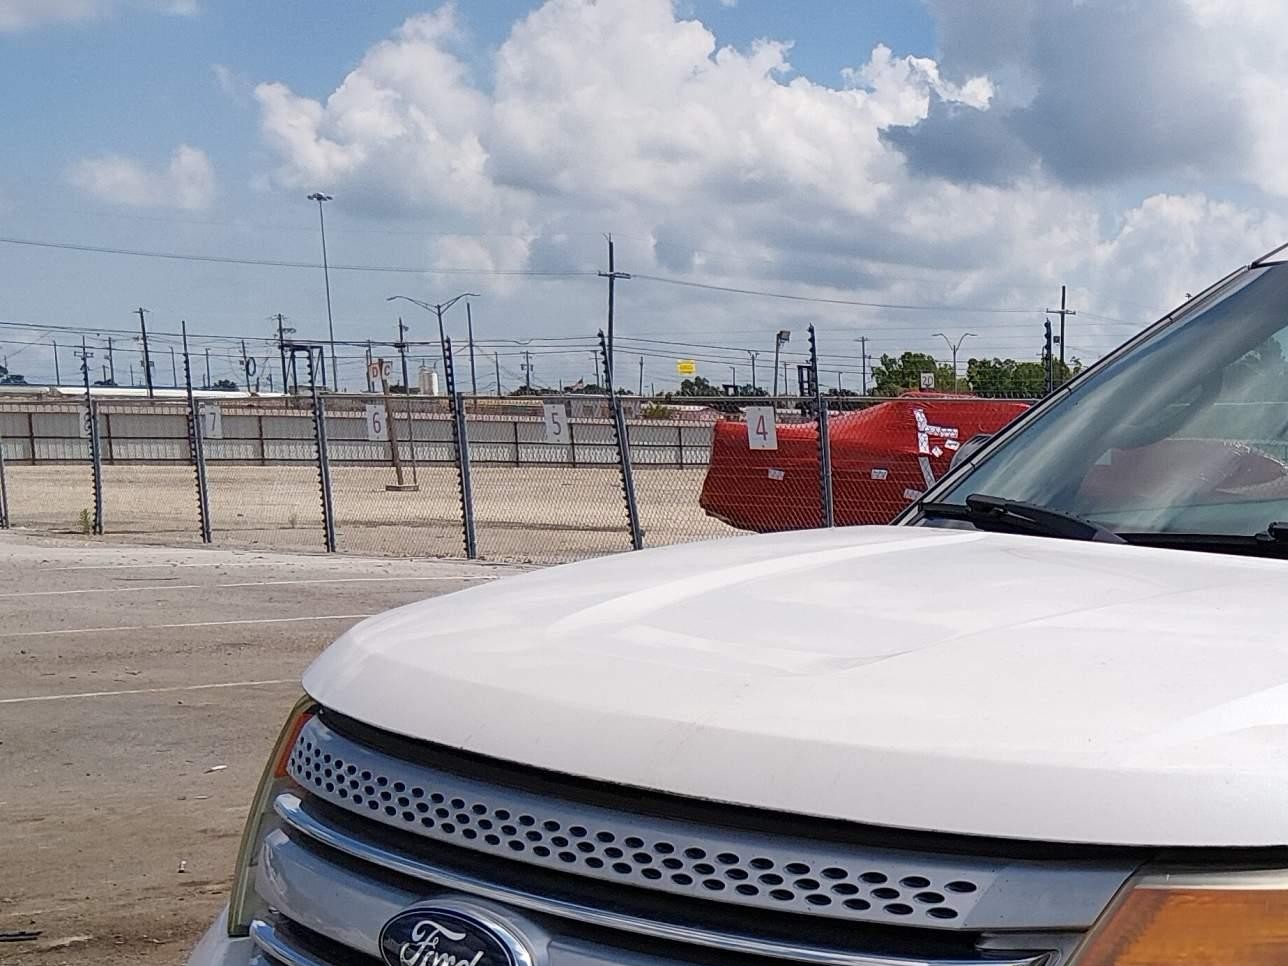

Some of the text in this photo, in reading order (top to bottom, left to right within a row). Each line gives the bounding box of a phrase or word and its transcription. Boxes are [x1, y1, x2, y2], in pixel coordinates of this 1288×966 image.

[922, 375, 934, 387] 20
[209, 412, 217, 432] 7
[372, 411, 382, 434] 6
[551, 412, 562, 435] 5
[755, 414, 768, 441] 4
